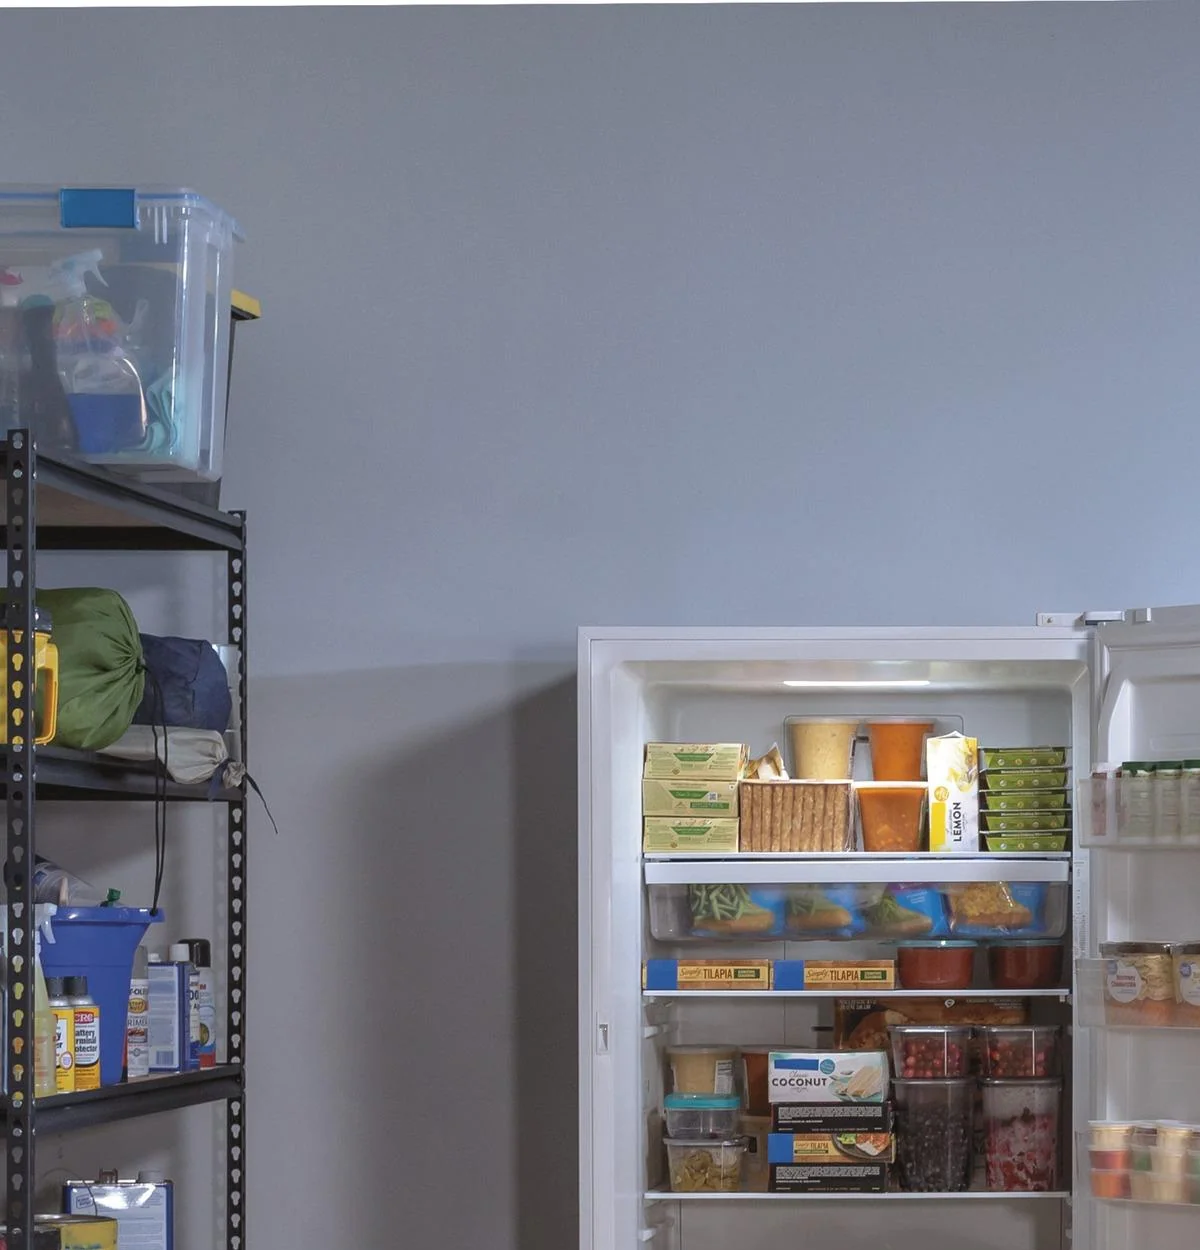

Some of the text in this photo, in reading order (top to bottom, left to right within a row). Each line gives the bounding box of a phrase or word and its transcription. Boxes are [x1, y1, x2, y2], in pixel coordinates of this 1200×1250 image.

[953, 801, 962, 842] LEMON
[703, 968, 733, 979] TILAPIA
[830, 969, 859, 981] TILAPIA
[75, 1013, 94, 1022] CRC
[771, 1078, 828, 1087] COCONUT
